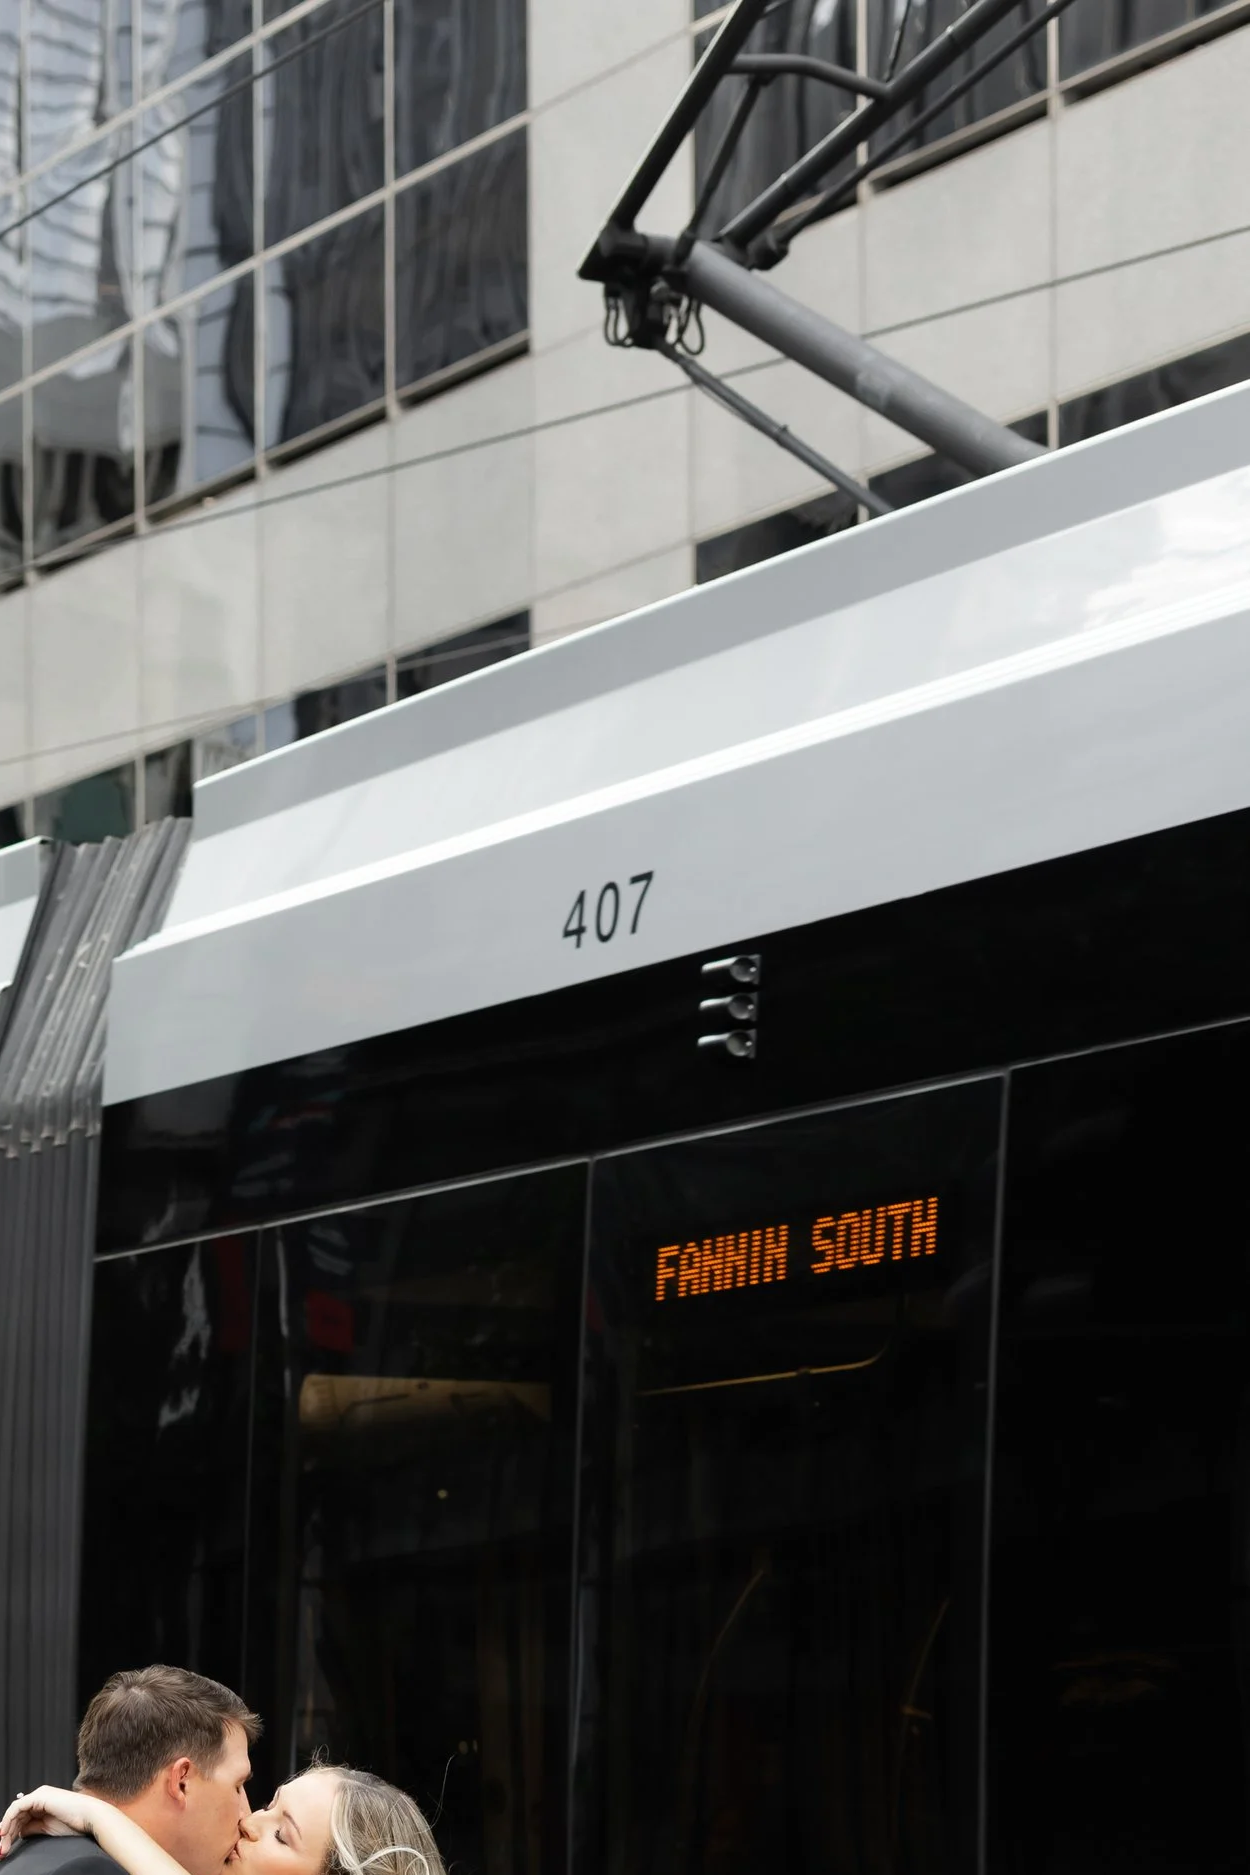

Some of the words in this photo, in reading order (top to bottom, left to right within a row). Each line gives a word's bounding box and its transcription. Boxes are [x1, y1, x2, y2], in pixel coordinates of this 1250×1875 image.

[562, 869, 655, 949] 407
[655, 1225, 790, 1301] FANNIN
[810, 1197, 939, 1274] SOUTH
